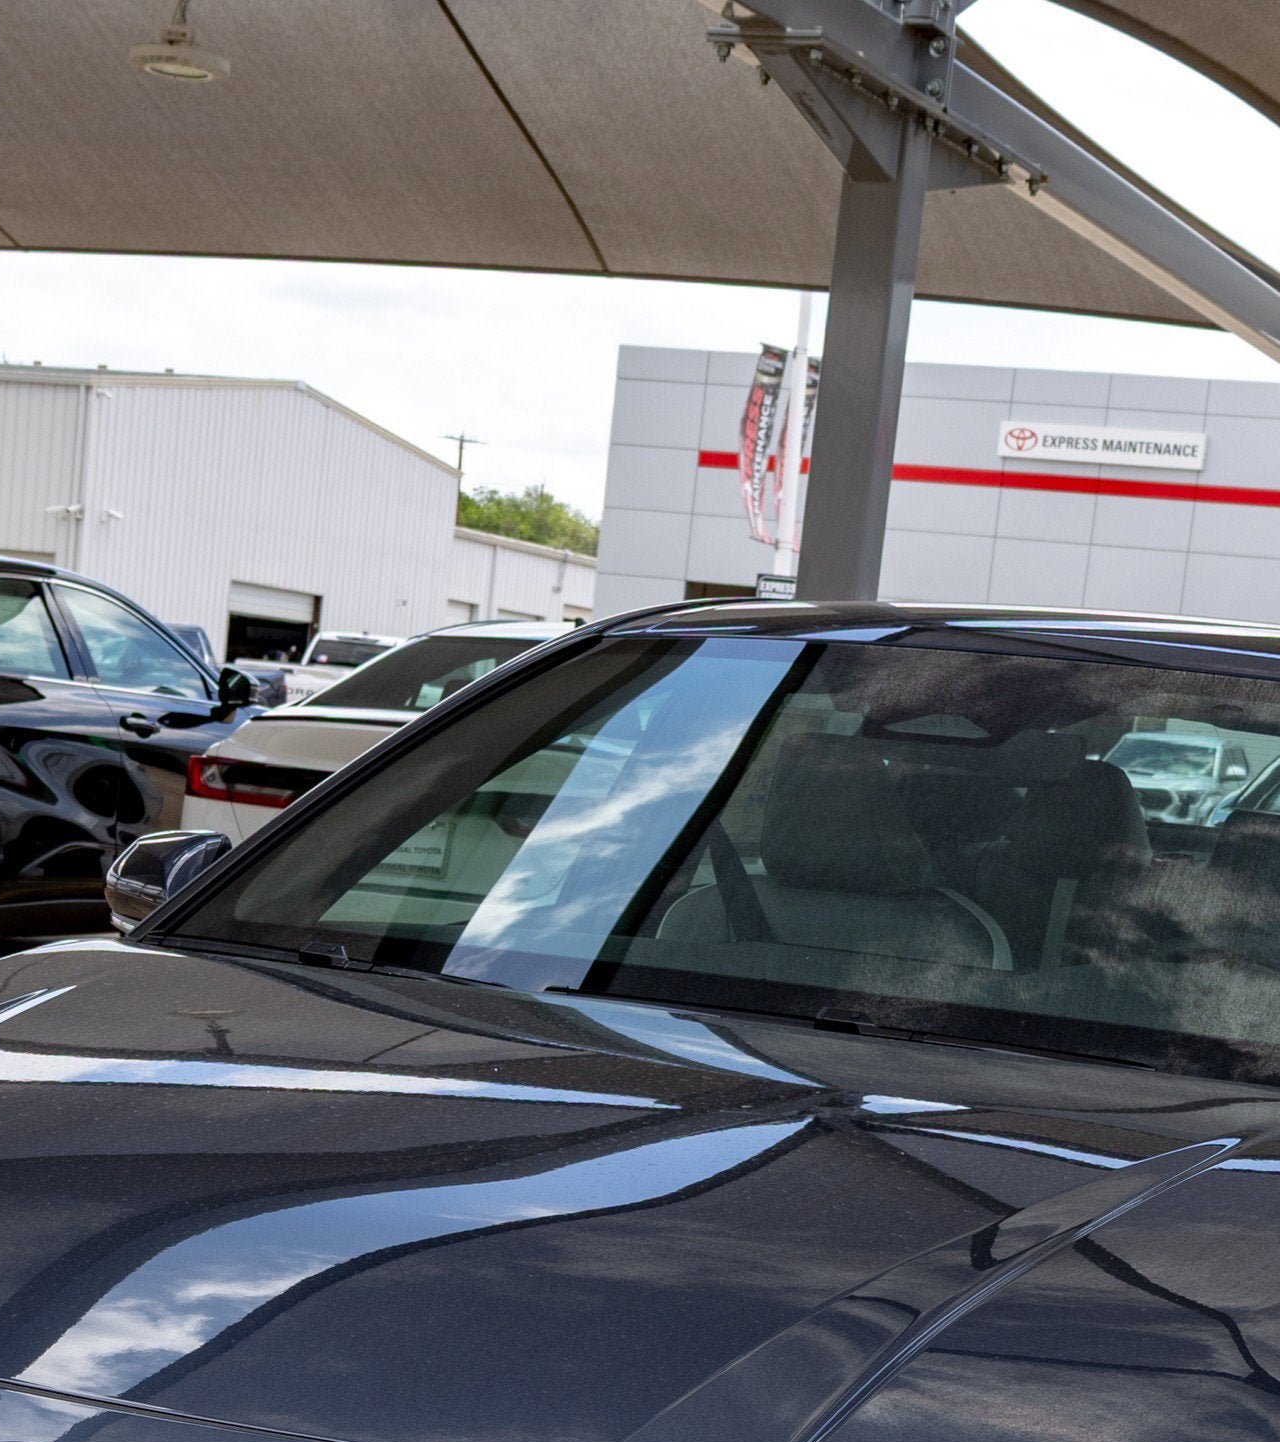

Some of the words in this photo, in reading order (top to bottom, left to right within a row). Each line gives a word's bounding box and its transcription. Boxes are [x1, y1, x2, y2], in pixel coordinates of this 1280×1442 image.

[753, 394, 773, 514] MAINTENANCE
[1042, 435, 1099, 451] EXPRESS
[1102, 439, 1199, 458] MAINTENANCE
